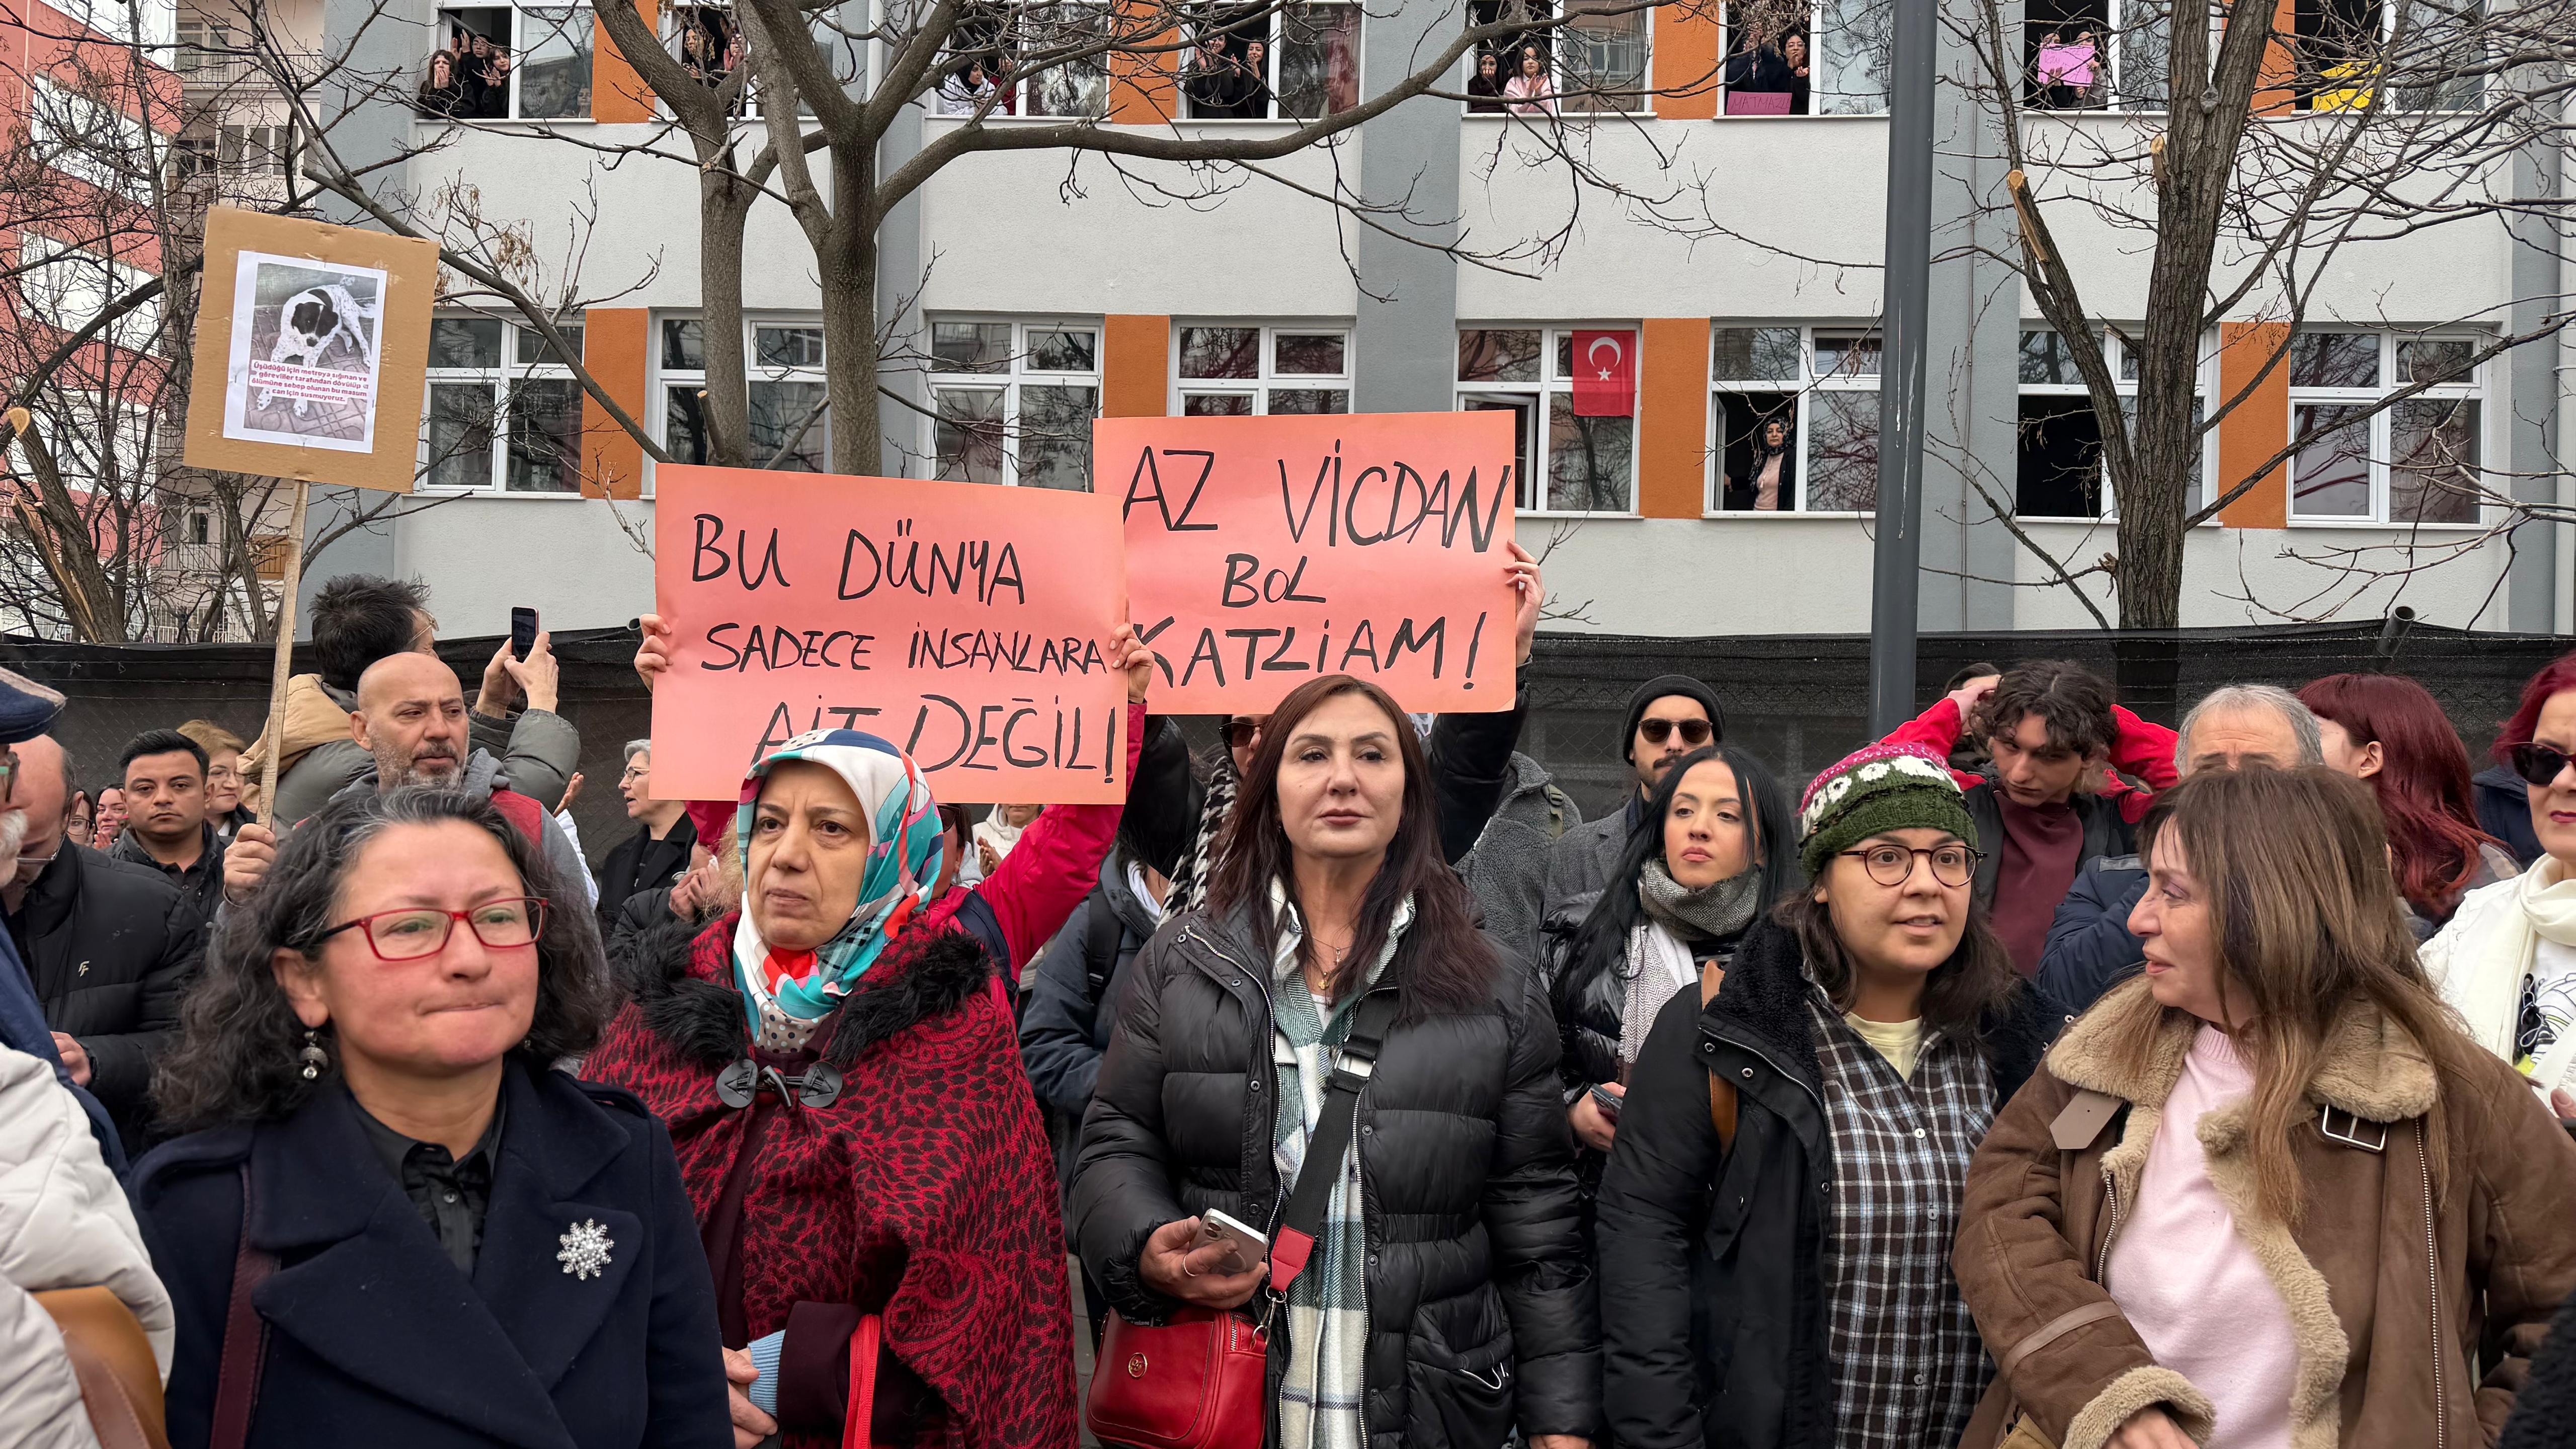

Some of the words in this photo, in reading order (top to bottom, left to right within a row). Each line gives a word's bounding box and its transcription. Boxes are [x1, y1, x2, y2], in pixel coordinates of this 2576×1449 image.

[252, 377, 282, 387] ölümüne
[284, 382, 305, 390] sebep
[254, 361, 285, 372] Üşüdüğü
[301, 369, 331, 377] metroya
[295, 375, 331, 385] tarafından
[333, 380, 361, 389] dövülüp
[1123, 446, 1218, 531] AZ
[1277, 439, 1511, 552] VİCDAN
[693, 513, 790, 590] BU
[838, 518, 1025, 606] DÜNYA
[701, 622, 875, 673] SADECE
[908, 622, 1107, 675] İNSANLARA
[905, 694, 1115, 783] DEĞİL!
